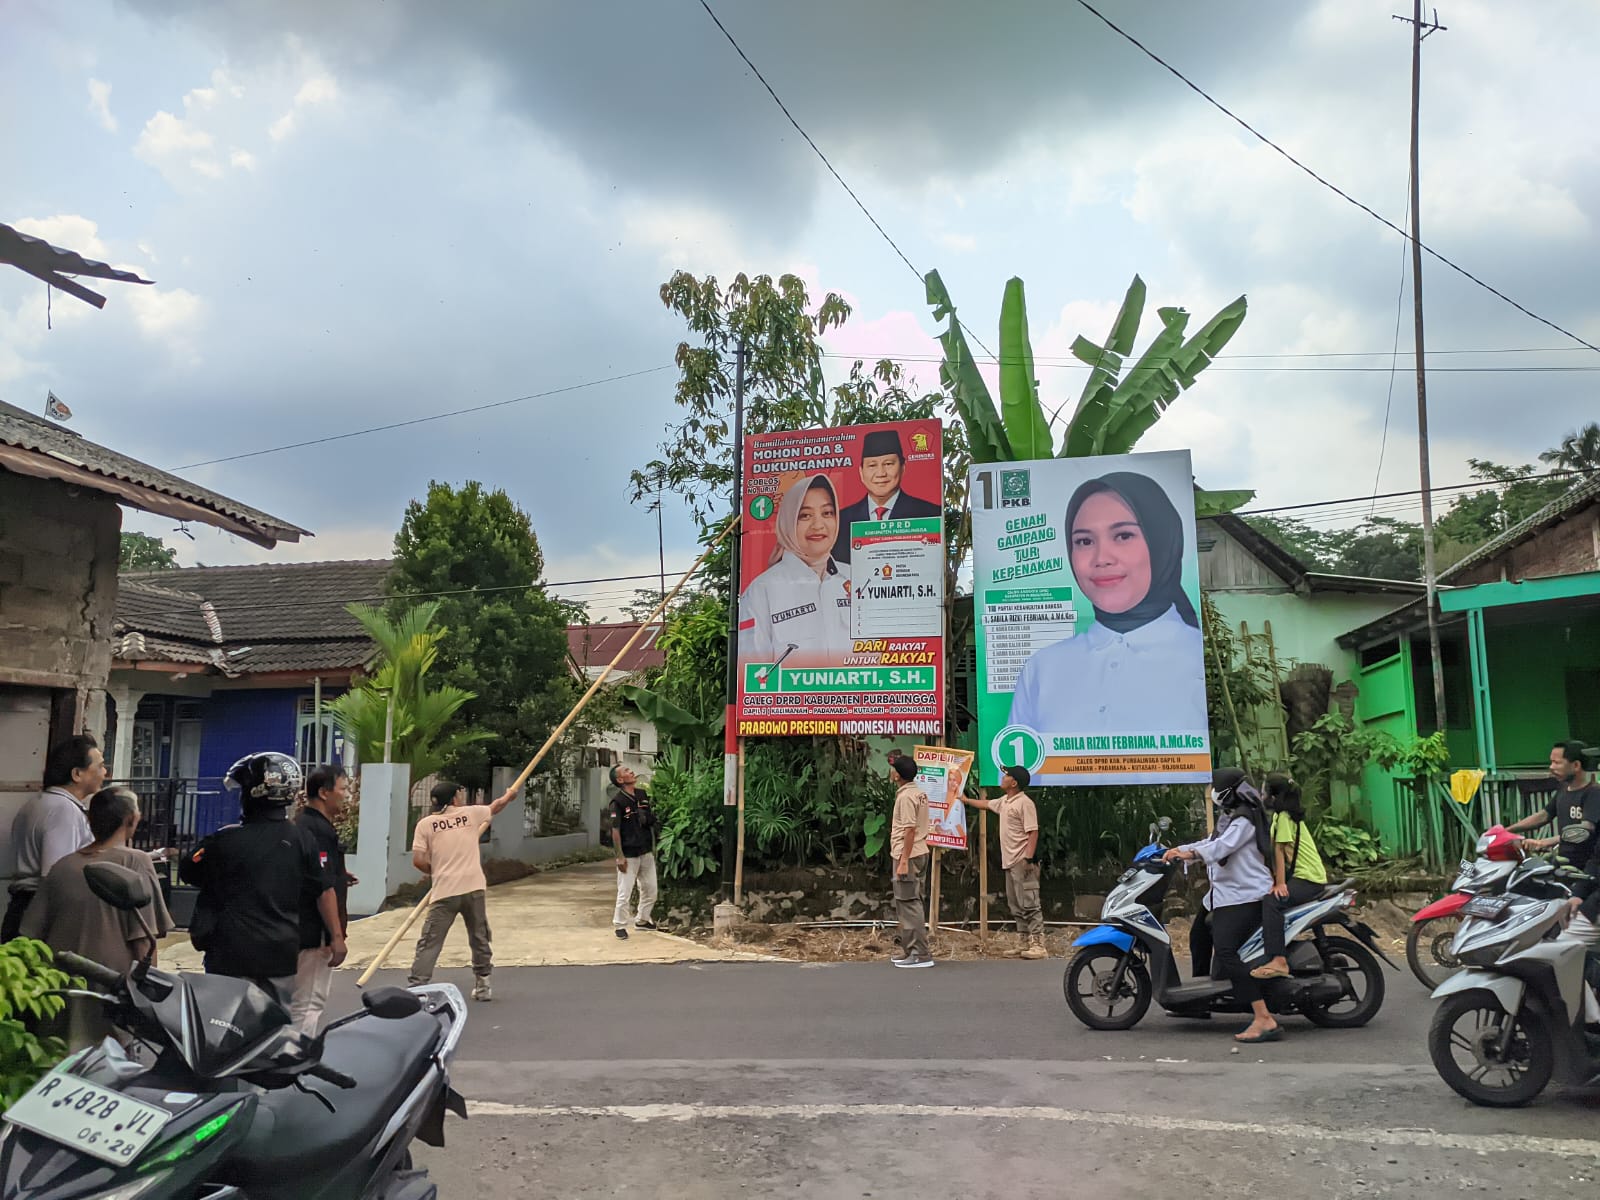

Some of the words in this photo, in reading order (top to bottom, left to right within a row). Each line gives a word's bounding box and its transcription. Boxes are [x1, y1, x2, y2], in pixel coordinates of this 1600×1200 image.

[753, 447, 800, 460] MOHON
[803, 445, 831, 456] DOA
[834, 443, 844, 454] &
[752, 457, 853, 474] DUKUNGANNYA
[747, 477, 779, 487] COBLOS
[976, 471, 993, 509] 1
[755, 498, 765, 518] 1
[1002, 498, 1031, 508] PKB
[1005, 513, 1046, 533] GENAH
[997, 527, 1056, 551] GAMPANG
[1014, 546, 1040, 563] TUR
[873, 567, 880, 576] 2
[992, 557, 1063, 583] KEPENAKAN
[868, 585, 915, 600] YUNIARTI,
[917, 584, 936, 598] S.H.
[853, 639, 887, 654] DARI
[888, 642, 927, 652] RAKYAT
[843, 656, 878, 666] UNTUK
[880, 651, 936, 665] RAKYAT
[789, 671, 884, 687] YUNIARTI,
[889, 670, 926, 685] S.H.
[743, 695, 773, 706] CALEG
[776, 695, 801, 705] DPRD
[804, 694, 860, 705] KABUPATEN
[862, 694, 936, 705] PURBALINGGA
[739, 721, 788, 735] PRABOWO
[790, 720, 838, 734] PRESIDEN
[840, 720, 894, 734] INDONESIA
[896, 719, 940, 734] MENANG
[1009, 736, 1025, 766] 1
[1053, 736, 1085, 751] SABILA
[1086, 735, 1110, 750] RIZKI
[1112, 735, 1158, 750] FEBRIANA,
[1160, 734, 1204, 749] A.Md.Kes
[1570, 805, 1583, 820] 86
[432, 816, 468, 833] POL-PP
[209, 1017, 245, 1038] HONDA
[38, 1077, 62, 1098] R
[62, 1086, 120, 1120] 4828
[126, 1108, 156, 1137] VL
